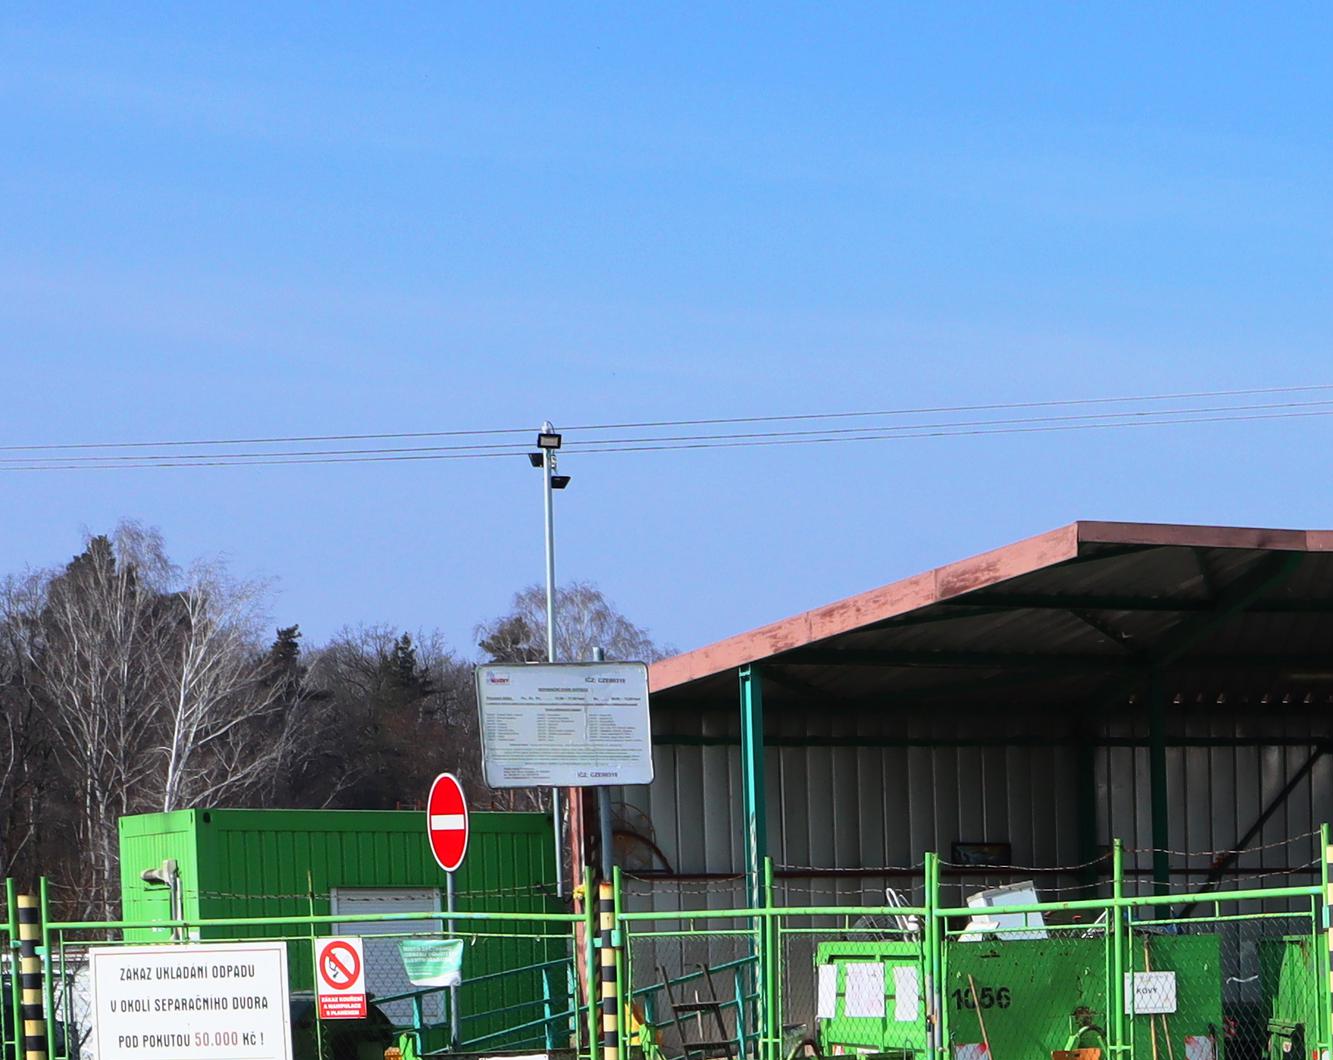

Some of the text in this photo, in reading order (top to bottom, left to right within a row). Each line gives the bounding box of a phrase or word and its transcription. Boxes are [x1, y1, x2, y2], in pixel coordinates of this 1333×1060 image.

[212, 965, 254, 978] ODPADU
[111, 995, 268, 1012] V OKOLÍ SEPARAČNÍHO DVORA
[951, 987, 1011, 1010] 1056
[119, 1035, 138, 1048] POD
[143, 1034, 190, 1047] POKUTOU
[195, 1032, 238, 1046] 50.000
[261, 1032, 264, 1045] !
